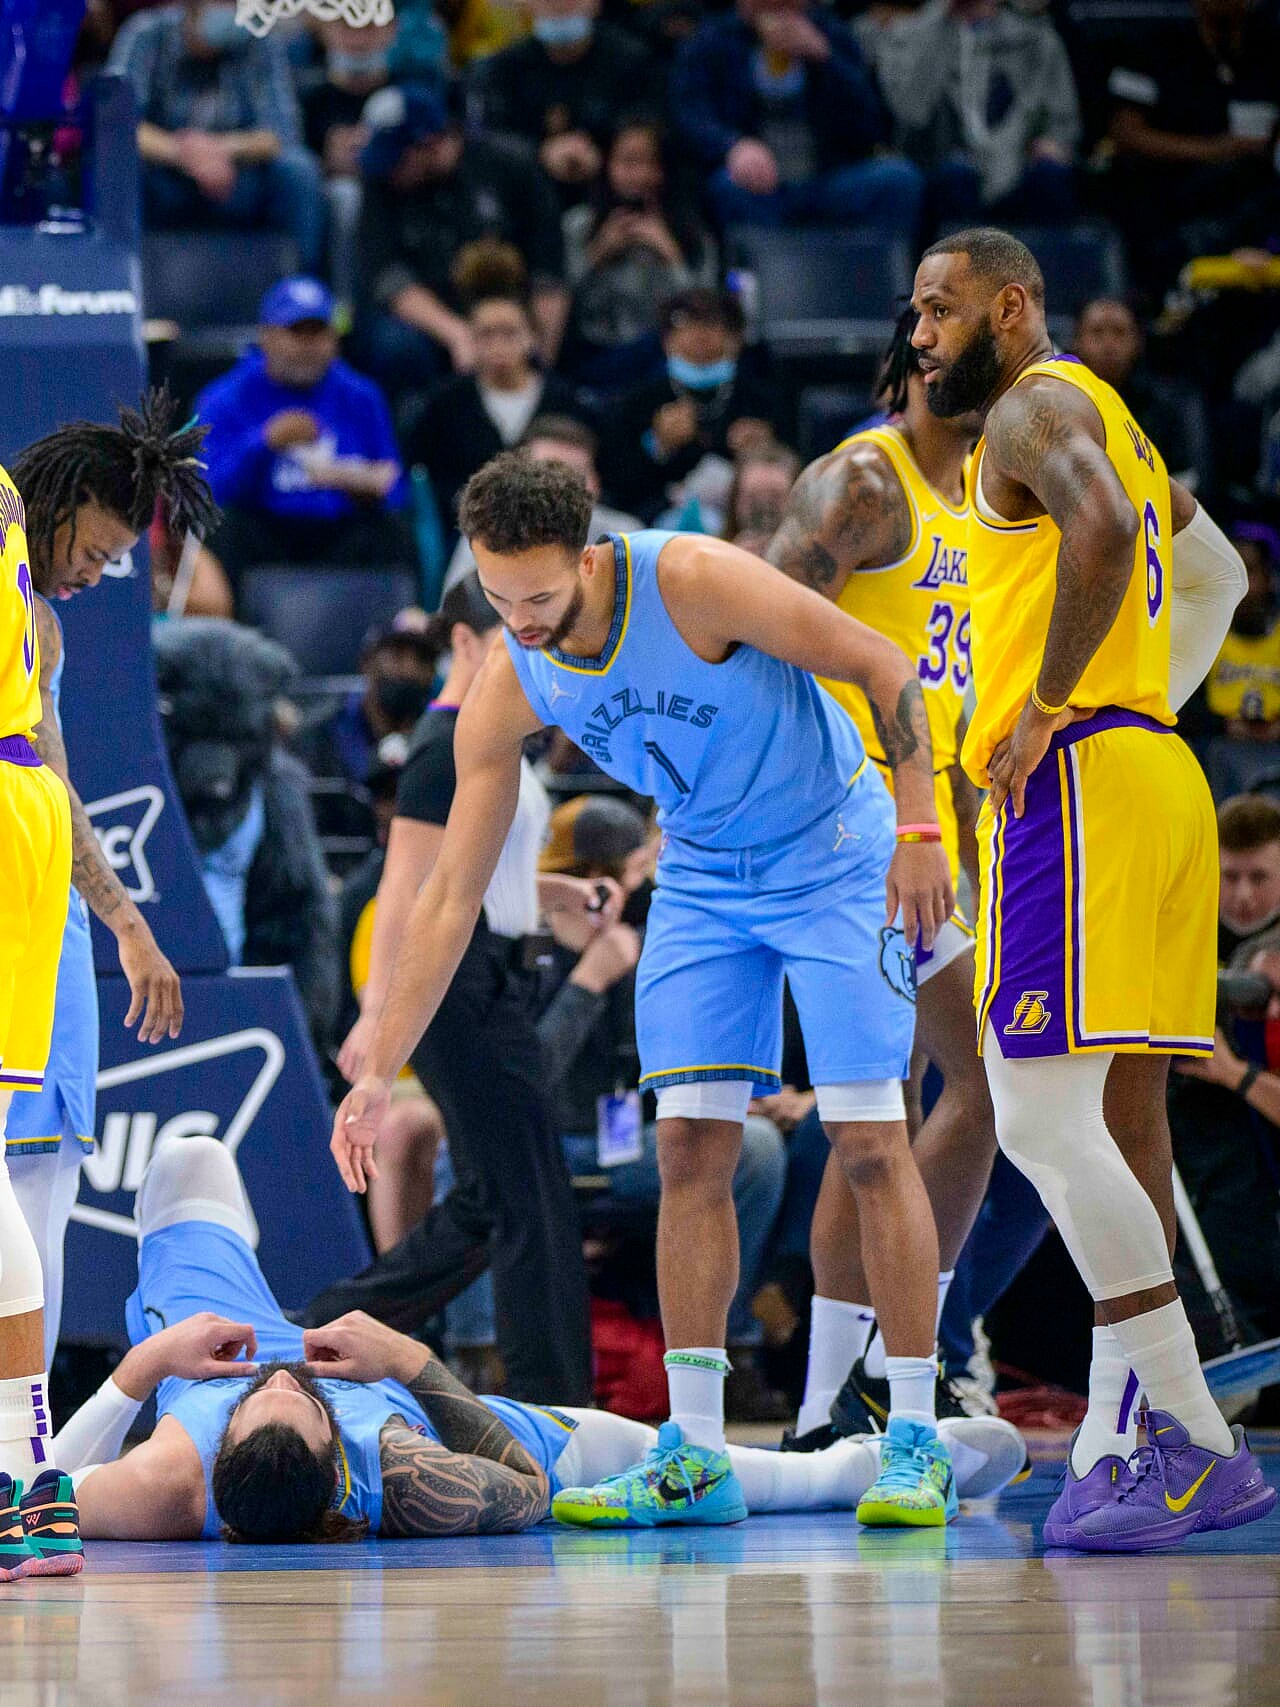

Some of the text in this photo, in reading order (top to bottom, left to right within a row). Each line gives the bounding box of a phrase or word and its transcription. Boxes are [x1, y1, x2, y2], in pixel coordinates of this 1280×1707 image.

[910, 535, 968, 589] LAK
[1144, 498, 1164, 630] 6
[918, 601, 971, 696] 39
[642, 741, 692, 795] 1
